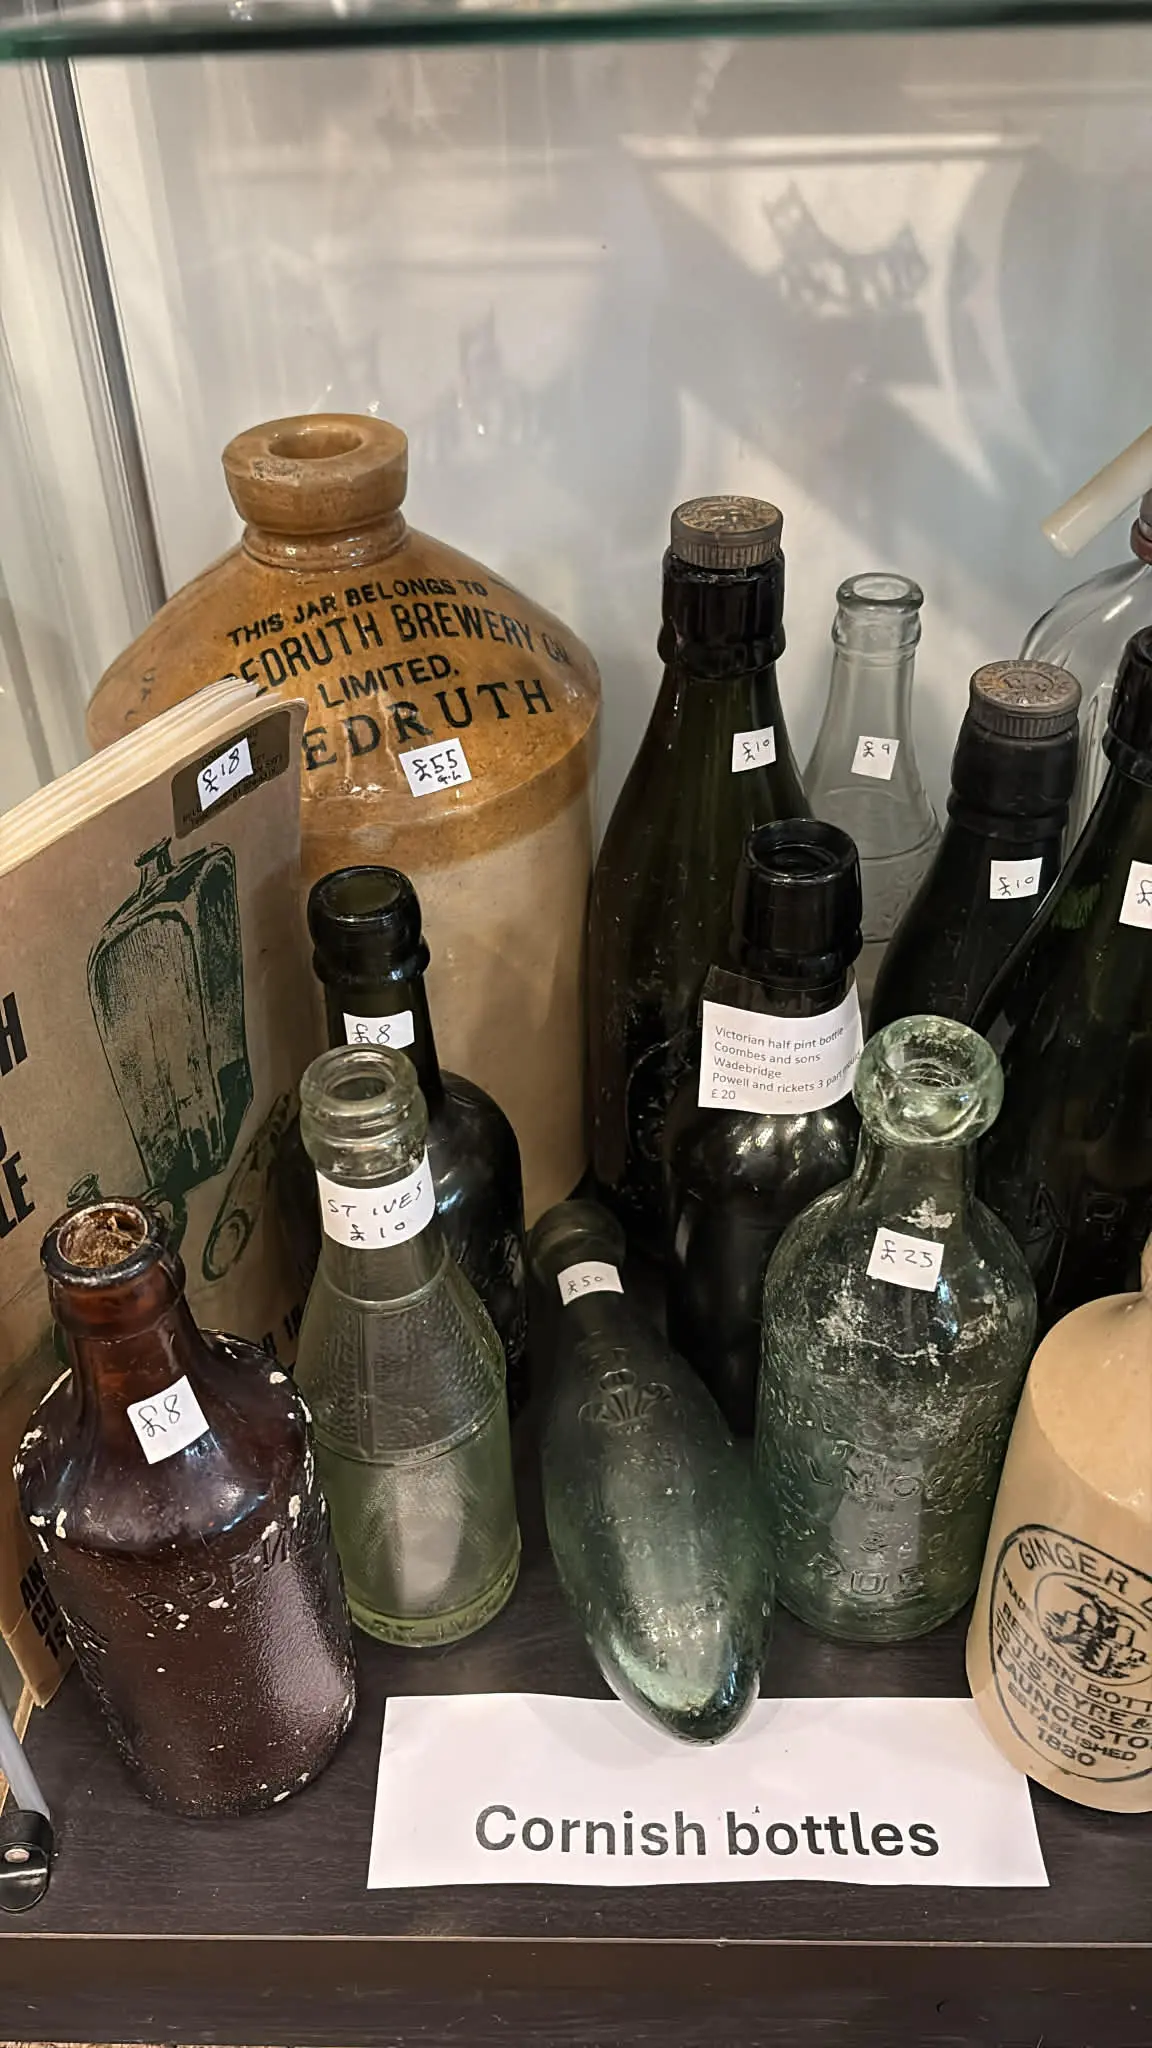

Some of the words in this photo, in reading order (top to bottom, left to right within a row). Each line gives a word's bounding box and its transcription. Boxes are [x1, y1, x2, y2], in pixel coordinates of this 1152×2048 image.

[227, 612, 284, 647] THIS
[294, 594, 337, 625] JAR
[344, 577, 457, 607] BELONGS
[456, 578, 489, 597] TO
[223, 610, 384, 698] EDRUTH
[389, 601, 536, 653] BREWERY
[411, 748, 459, 782] £55
[742, 738, 771, 763] £10
[862, 740, 890, 759] £9
[202, 746, 241, 793] £18
[997, 876, 1034, 897] £10
[351, 1022, 392, 1045] £8
[714, 1025, 765, 1047] Victorian
[768, 1039, 792, 1050] half
[794, 1039, 817, 1051] pint
[819, 1026, 844, 1046] bottle
[713, 1056, 782, 1079] Wadebridge
[714, 1041, 766, 1062] Coombes
[769, 1054, 792, 1064] and
[795, 1053, 821, 1064] sons
[712, 1072, 749, 1087] Powell
[752, 1080, 774, 1092] and
[777, 1082, 815, 1093] rickets
[817, 1079, 824, 1089] 3
[327, 1199, 356, 1218] ST
[350, 1220, 406, 1242] £10
[879, 1239, 935, 1270] £25
[566, 1274, 604, 1295] £50
[137, 1391, 182, 1439] £8
[1018, 1537, 1129, 1594] GINGER
[1002, 1601, 1077, 1685] RETURN
[996, 1643, 1152, 1750] LAUNCESTO
[1053, 1682, 1127, 1728] EYRE
[1007, 1681, 1137, 1762] ESTABLISHED
[475, 1804, 707, 1857] Cornish
[727, 1810, 940, 1857] bottles
